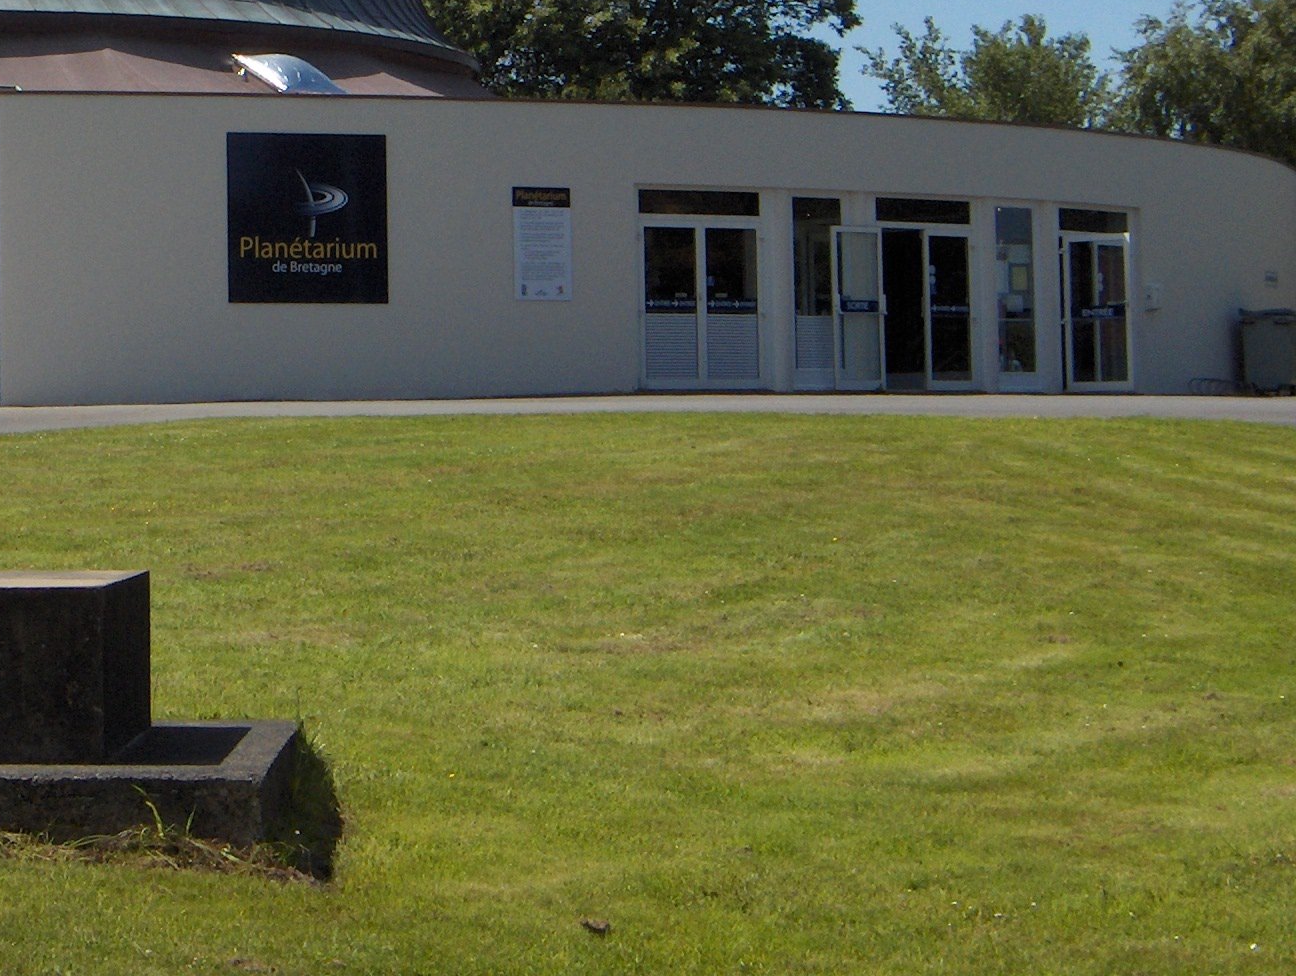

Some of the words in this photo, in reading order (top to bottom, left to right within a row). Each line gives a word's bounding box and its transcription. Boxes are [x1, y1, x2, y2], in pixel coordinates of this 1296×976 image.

[239, 236, 378, 259] Planétarium
[272, 260, 288, 273] de
[290, 261, 343, 276] Bretagne
